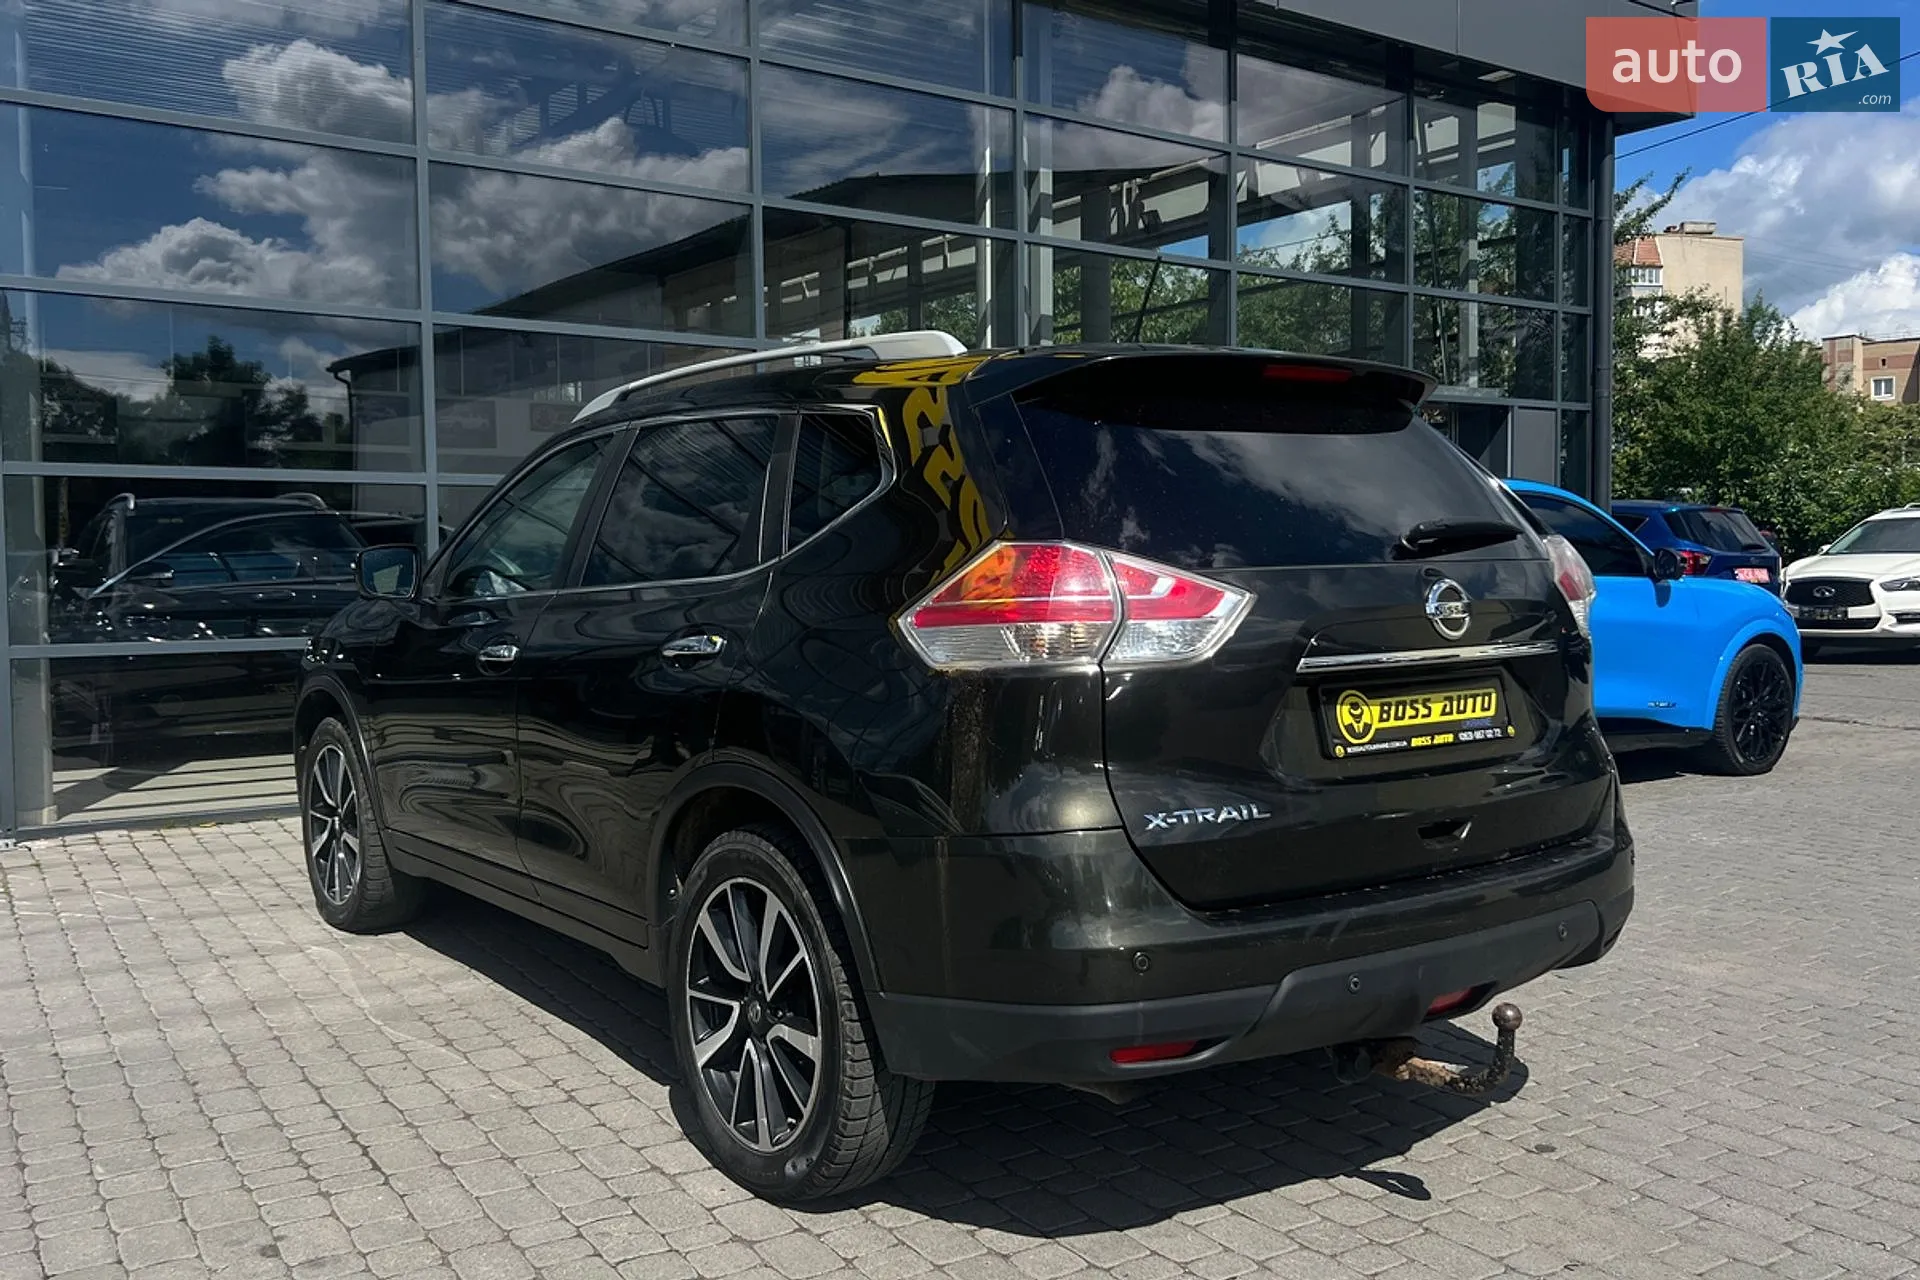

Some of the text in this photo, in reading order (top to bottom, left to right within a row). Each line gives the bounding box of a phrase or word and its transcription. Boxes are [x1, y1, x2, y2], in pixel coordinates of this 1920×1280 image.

[1379, 693, 1492, 723] BOSS AUTO
[1411, 736, 1431, 747] BOSS
[1433, 733, 1454, 744] AUTO
[1144, 803, 1271, 830] X-TRAIL
